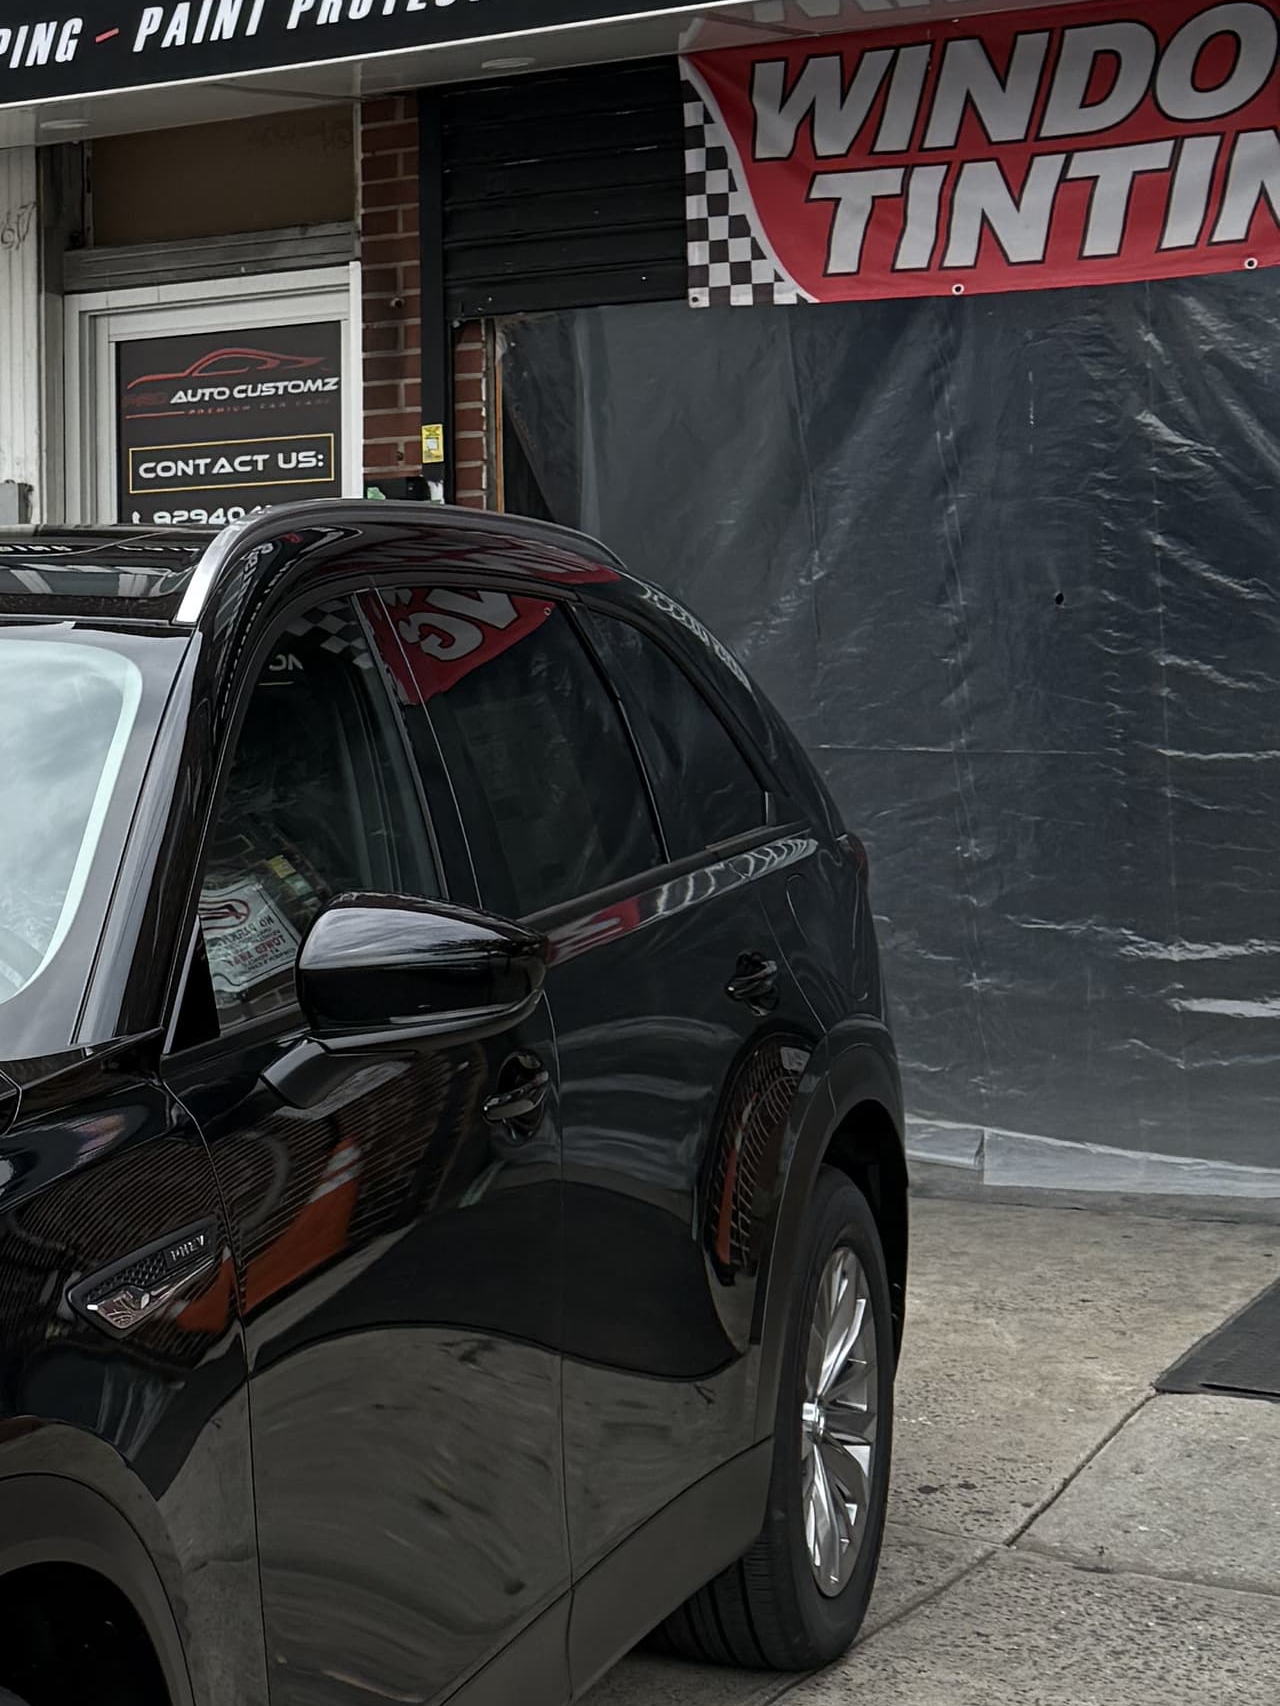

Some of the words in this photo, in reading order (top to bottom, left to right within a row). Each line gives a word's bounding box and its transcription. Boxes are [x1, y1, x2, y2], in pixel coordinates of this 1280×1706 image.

[749, 0, 1280, 161] WINDO
[805, 128, 1280, 277] TINTIN
[170, 387, 229, 404] AUTO
[233, 377, 340, 398] CUSTOMZ
[139, 454, 270, 479] CONTACT
[278, 451, 325, 469] US:
